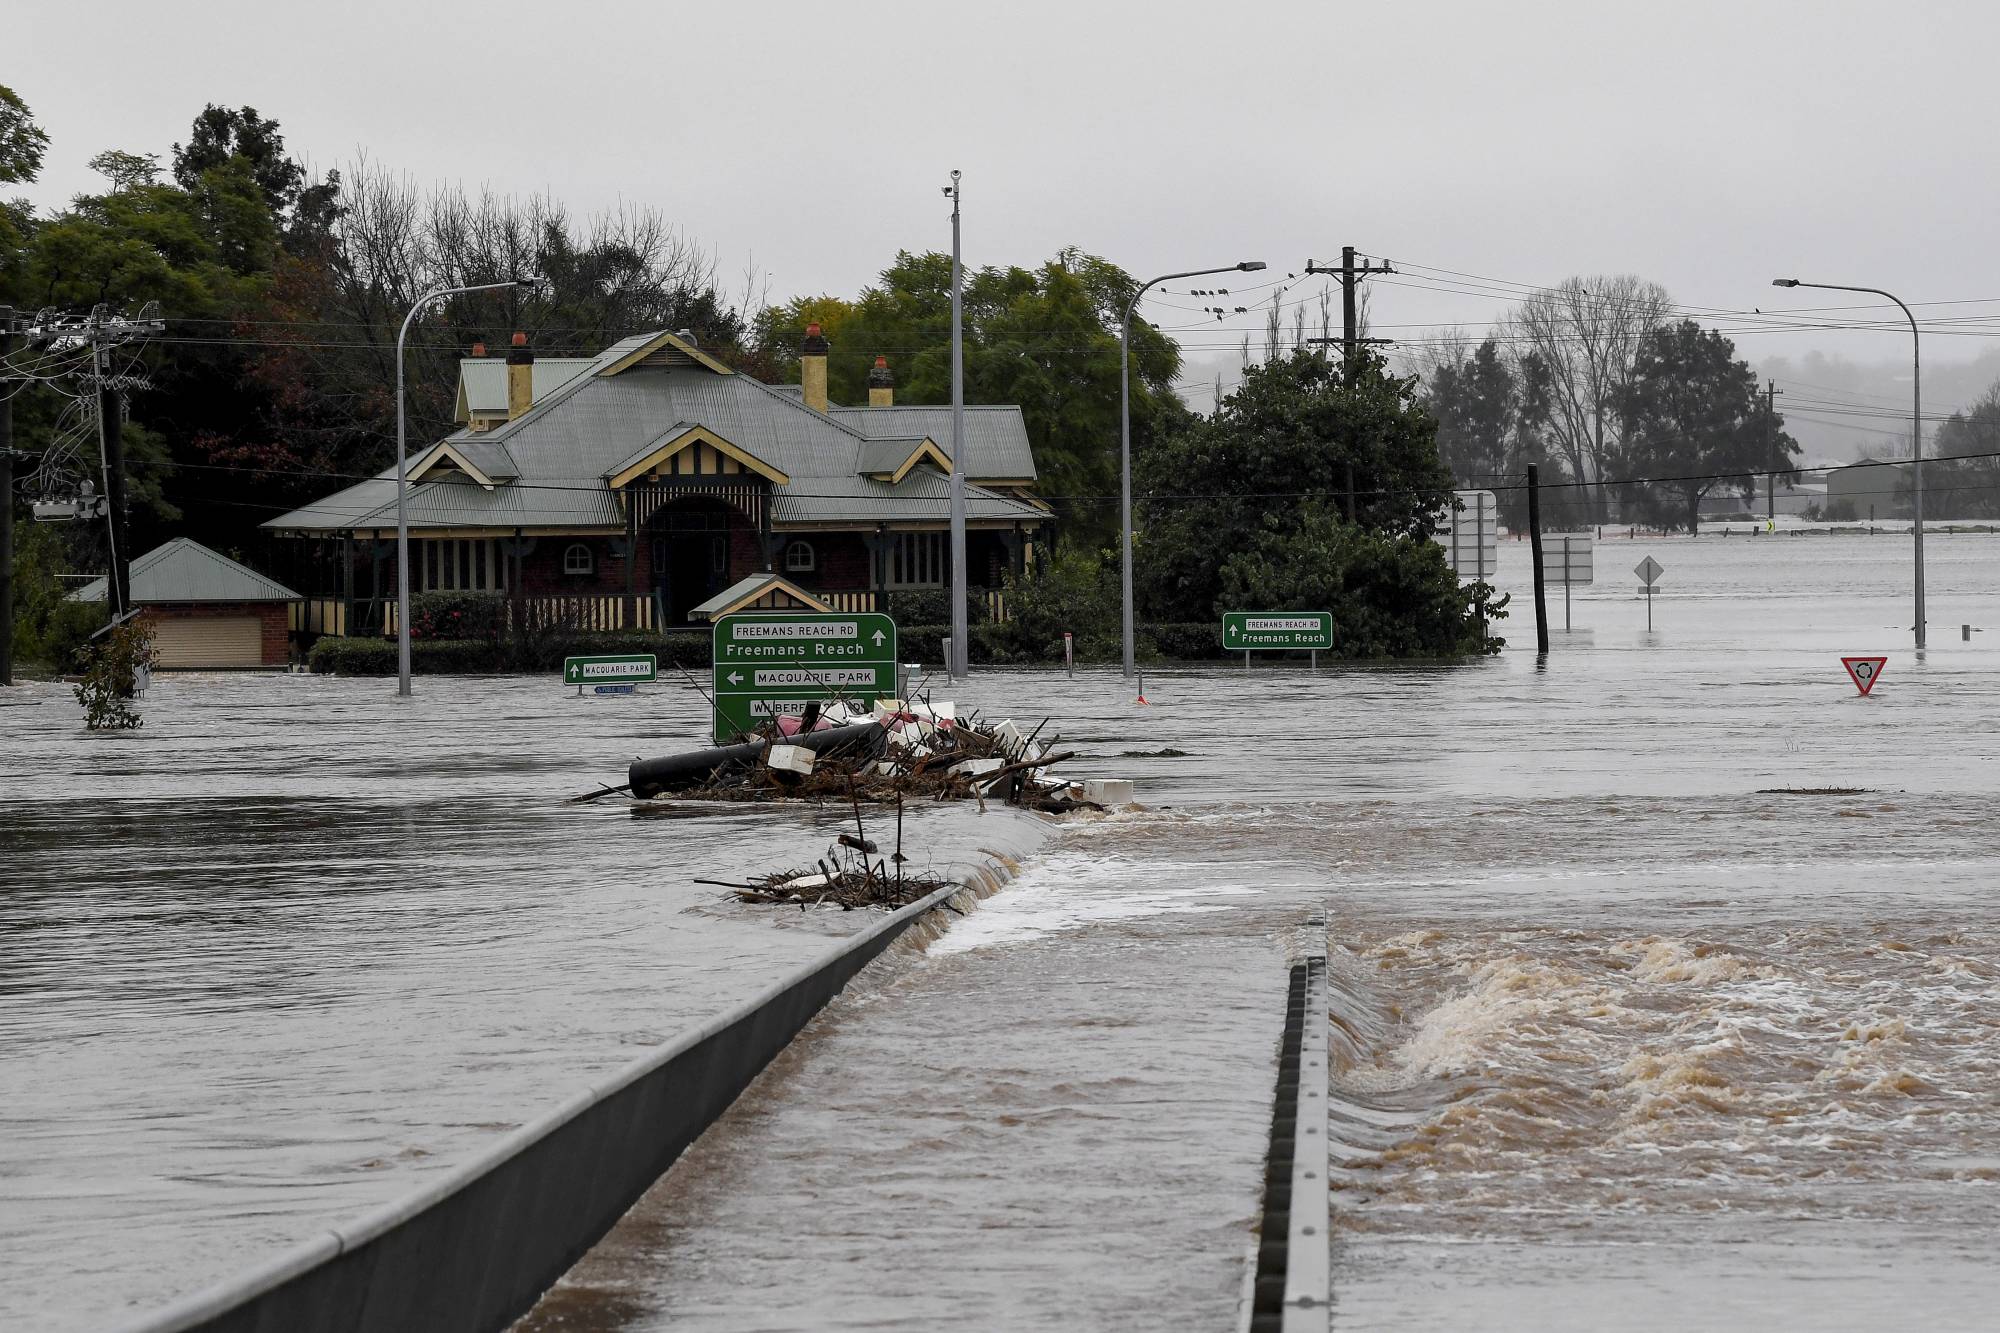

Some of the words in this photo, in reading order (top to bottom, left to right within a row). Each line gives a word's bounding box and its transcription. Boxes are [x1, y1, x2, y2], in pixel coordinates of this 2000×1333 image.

[1247, 621, 1283, 629] FREEMANS
[1285, 621, 1307, 629] REACH
[736, 626, 793, 636] FREEMANS
[799, 626, 834, 636] REACH
[840, 625, 854, 635] RD
[1242, 633, 1290, 643] Freemans
[1295, 633, 1325, 643] Reach
[726, 644, 805, 656] Freemans
[815, 643, 864, 655] Reach
[585, 665, 626, 674] MACQUARIE
[630, 664, 649, 673] PARK
[758, 673, 831, 683] MACQUARIE
[838, 672, 872, 682] PARK
